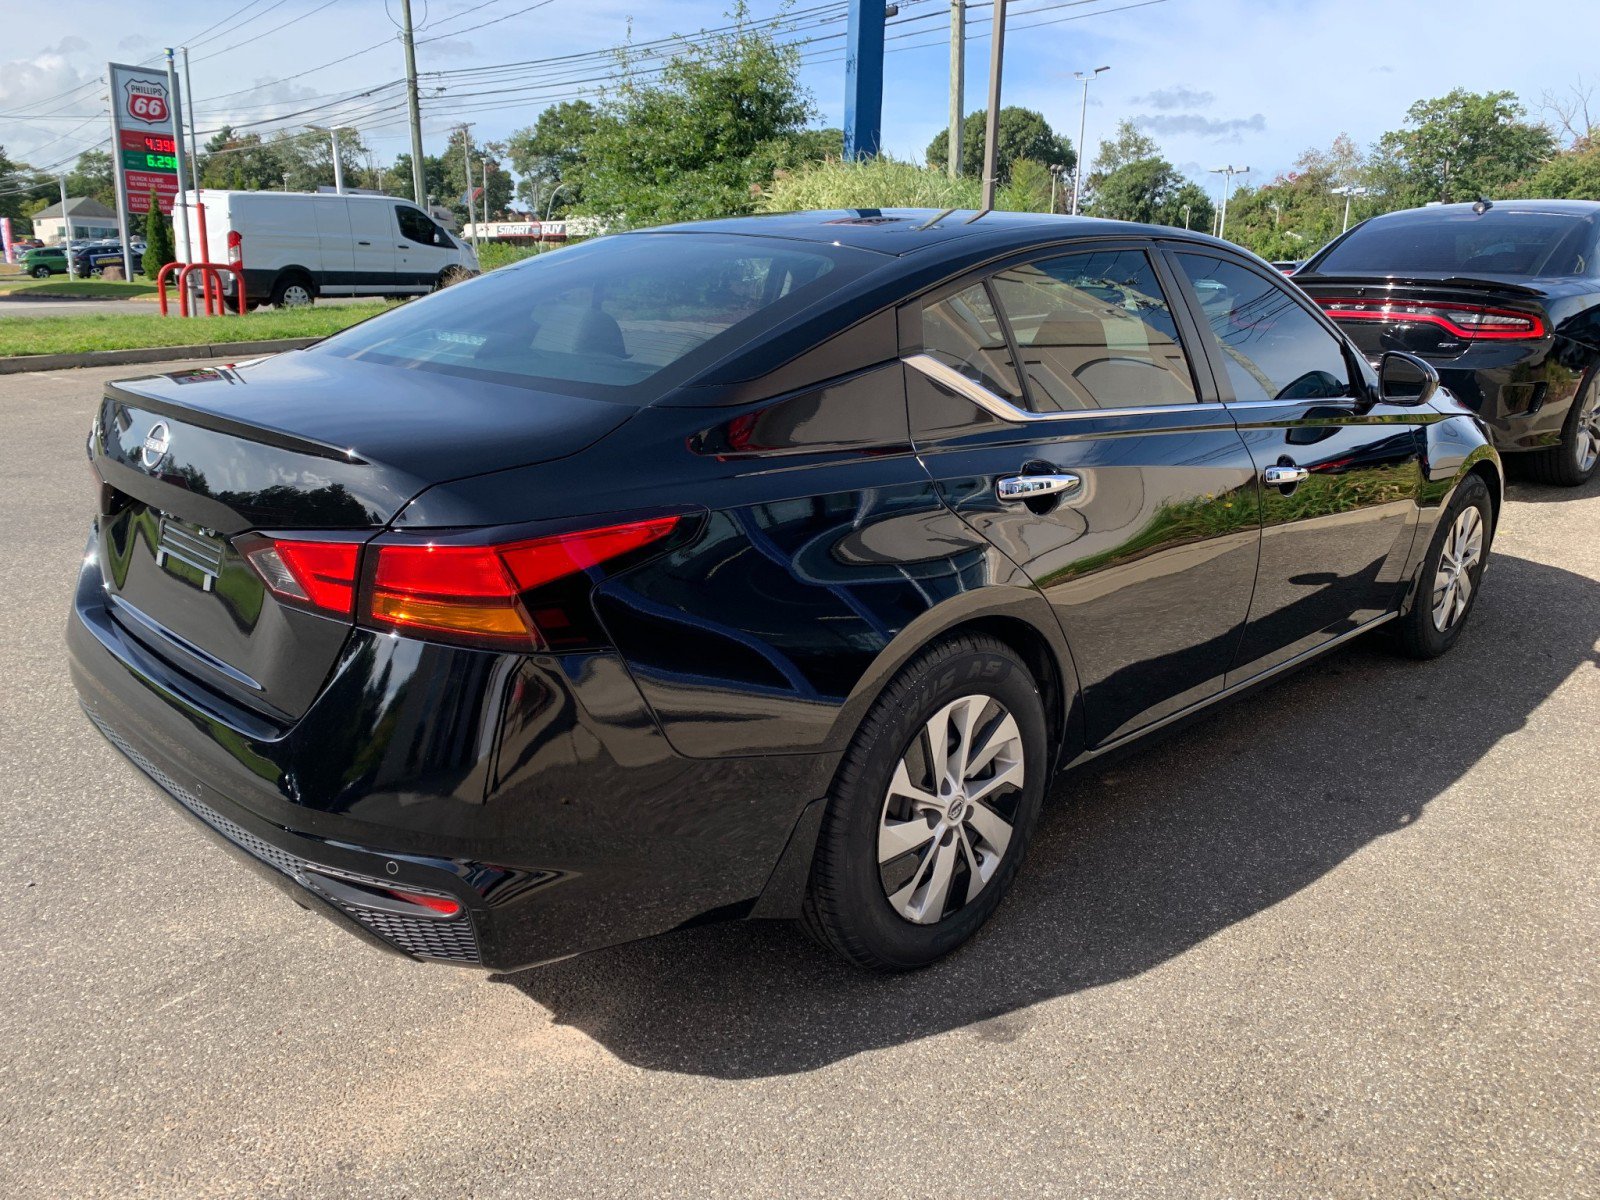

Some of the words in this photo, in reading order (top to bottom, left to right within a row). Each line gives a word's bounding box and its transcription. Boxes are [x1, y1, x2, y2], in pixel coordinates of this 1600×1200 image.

[131, 85, 162, 96] PHILLIPS
[134, 97, 161, 115] 66
[498, 225, 531, 235] SMART
[541, 224, 562, 234] BUY
